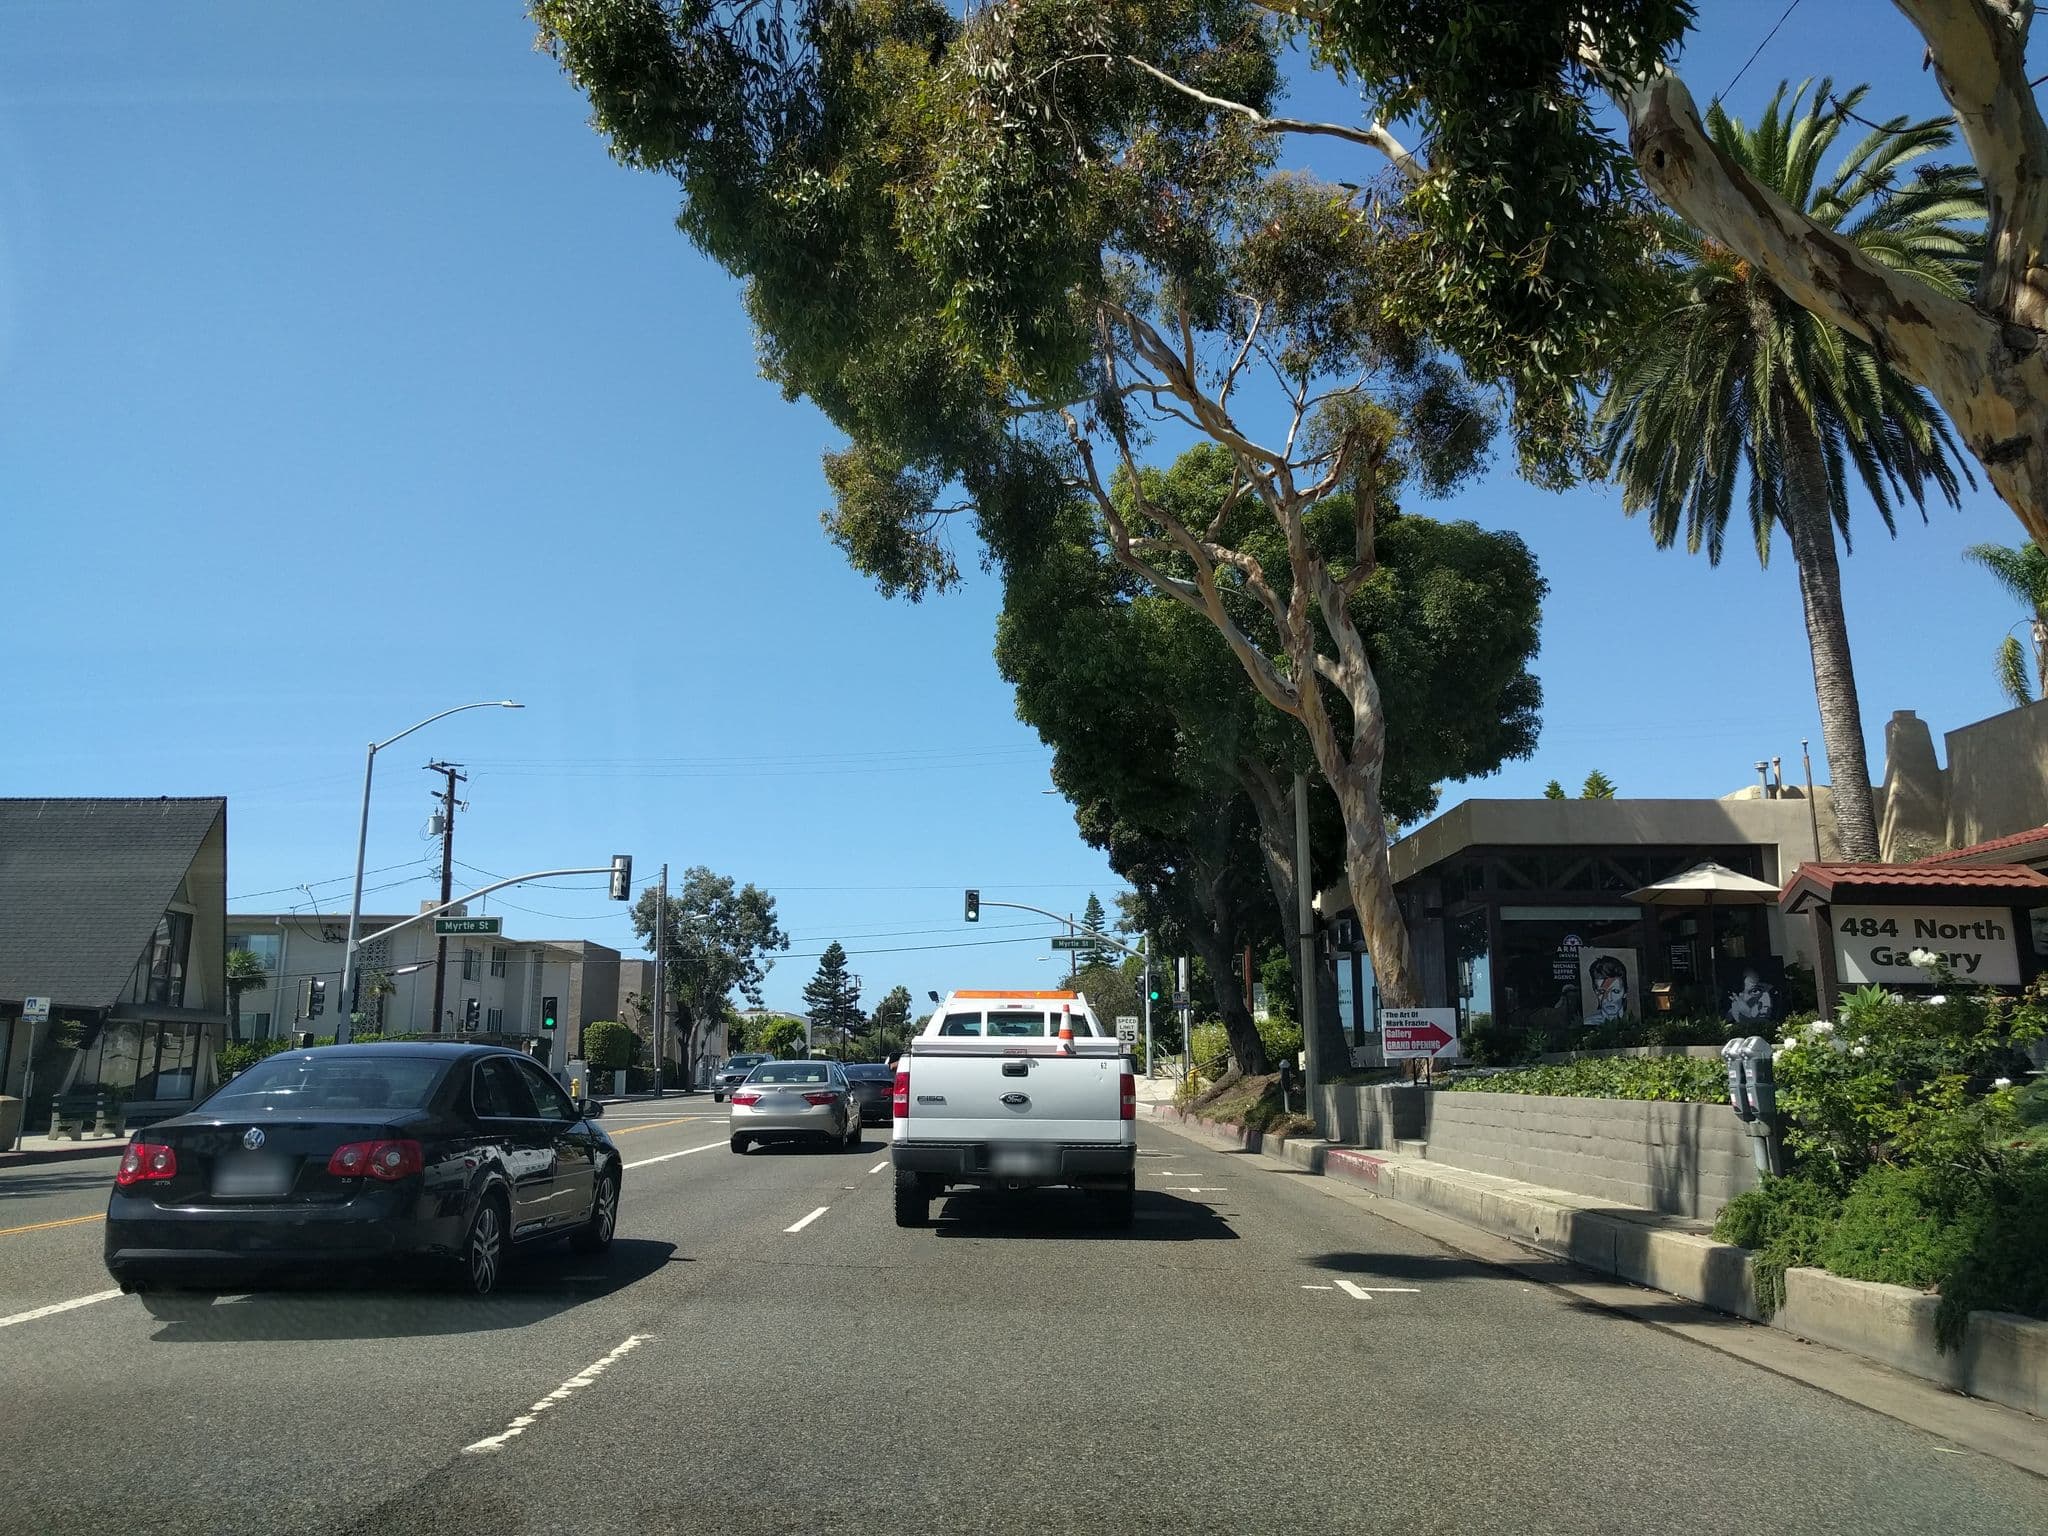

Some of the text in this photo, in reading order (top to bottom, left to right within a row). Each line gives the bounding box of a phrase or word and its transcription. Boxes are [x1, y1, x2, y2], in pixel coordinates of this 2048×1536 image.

[445, 921, 489, 931] Myrtle St
[1840, 917, 2006, 941] 484 North
[1870, 945, 1982, 974] Gaery
[1119, 1030, 1135, 1041] 35
[1386, 1029, 1412, 1038] Gallery
[1387, 1040, 1440, 1050] GRAND OPENING
